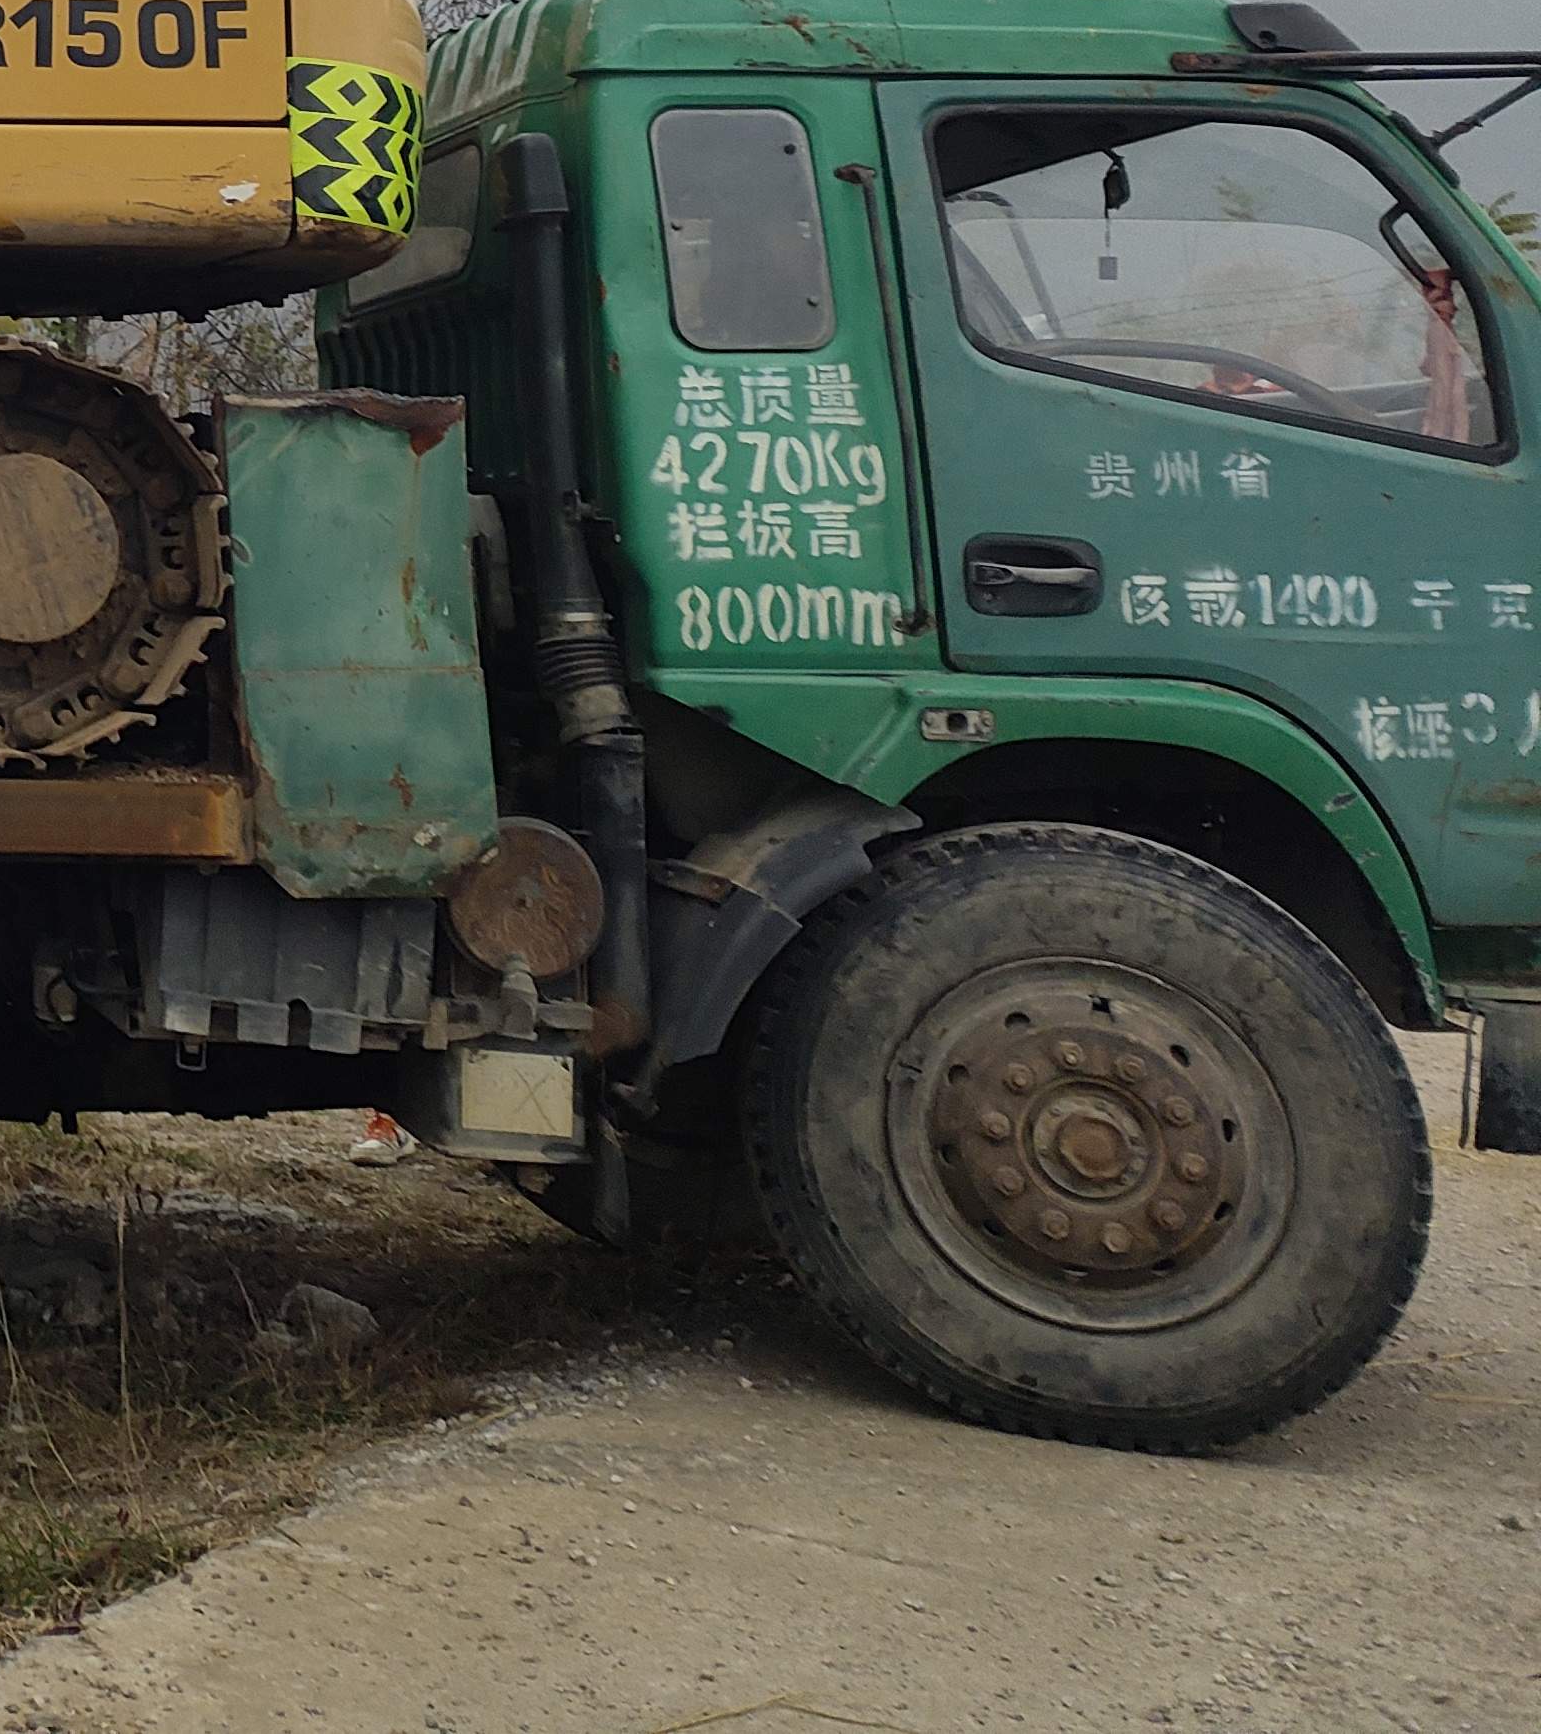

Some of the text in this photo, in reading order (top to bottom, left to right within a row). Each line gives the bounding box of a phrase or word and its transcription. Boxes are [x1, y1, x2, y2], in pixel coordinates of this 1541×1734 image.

[674, 363, 866, 428] 总质量
[650, 429, 888, 507] 4270Kg
[1083, 448, 1272, 500] 贵州省
[675, 582, 905, 652] 800mm
